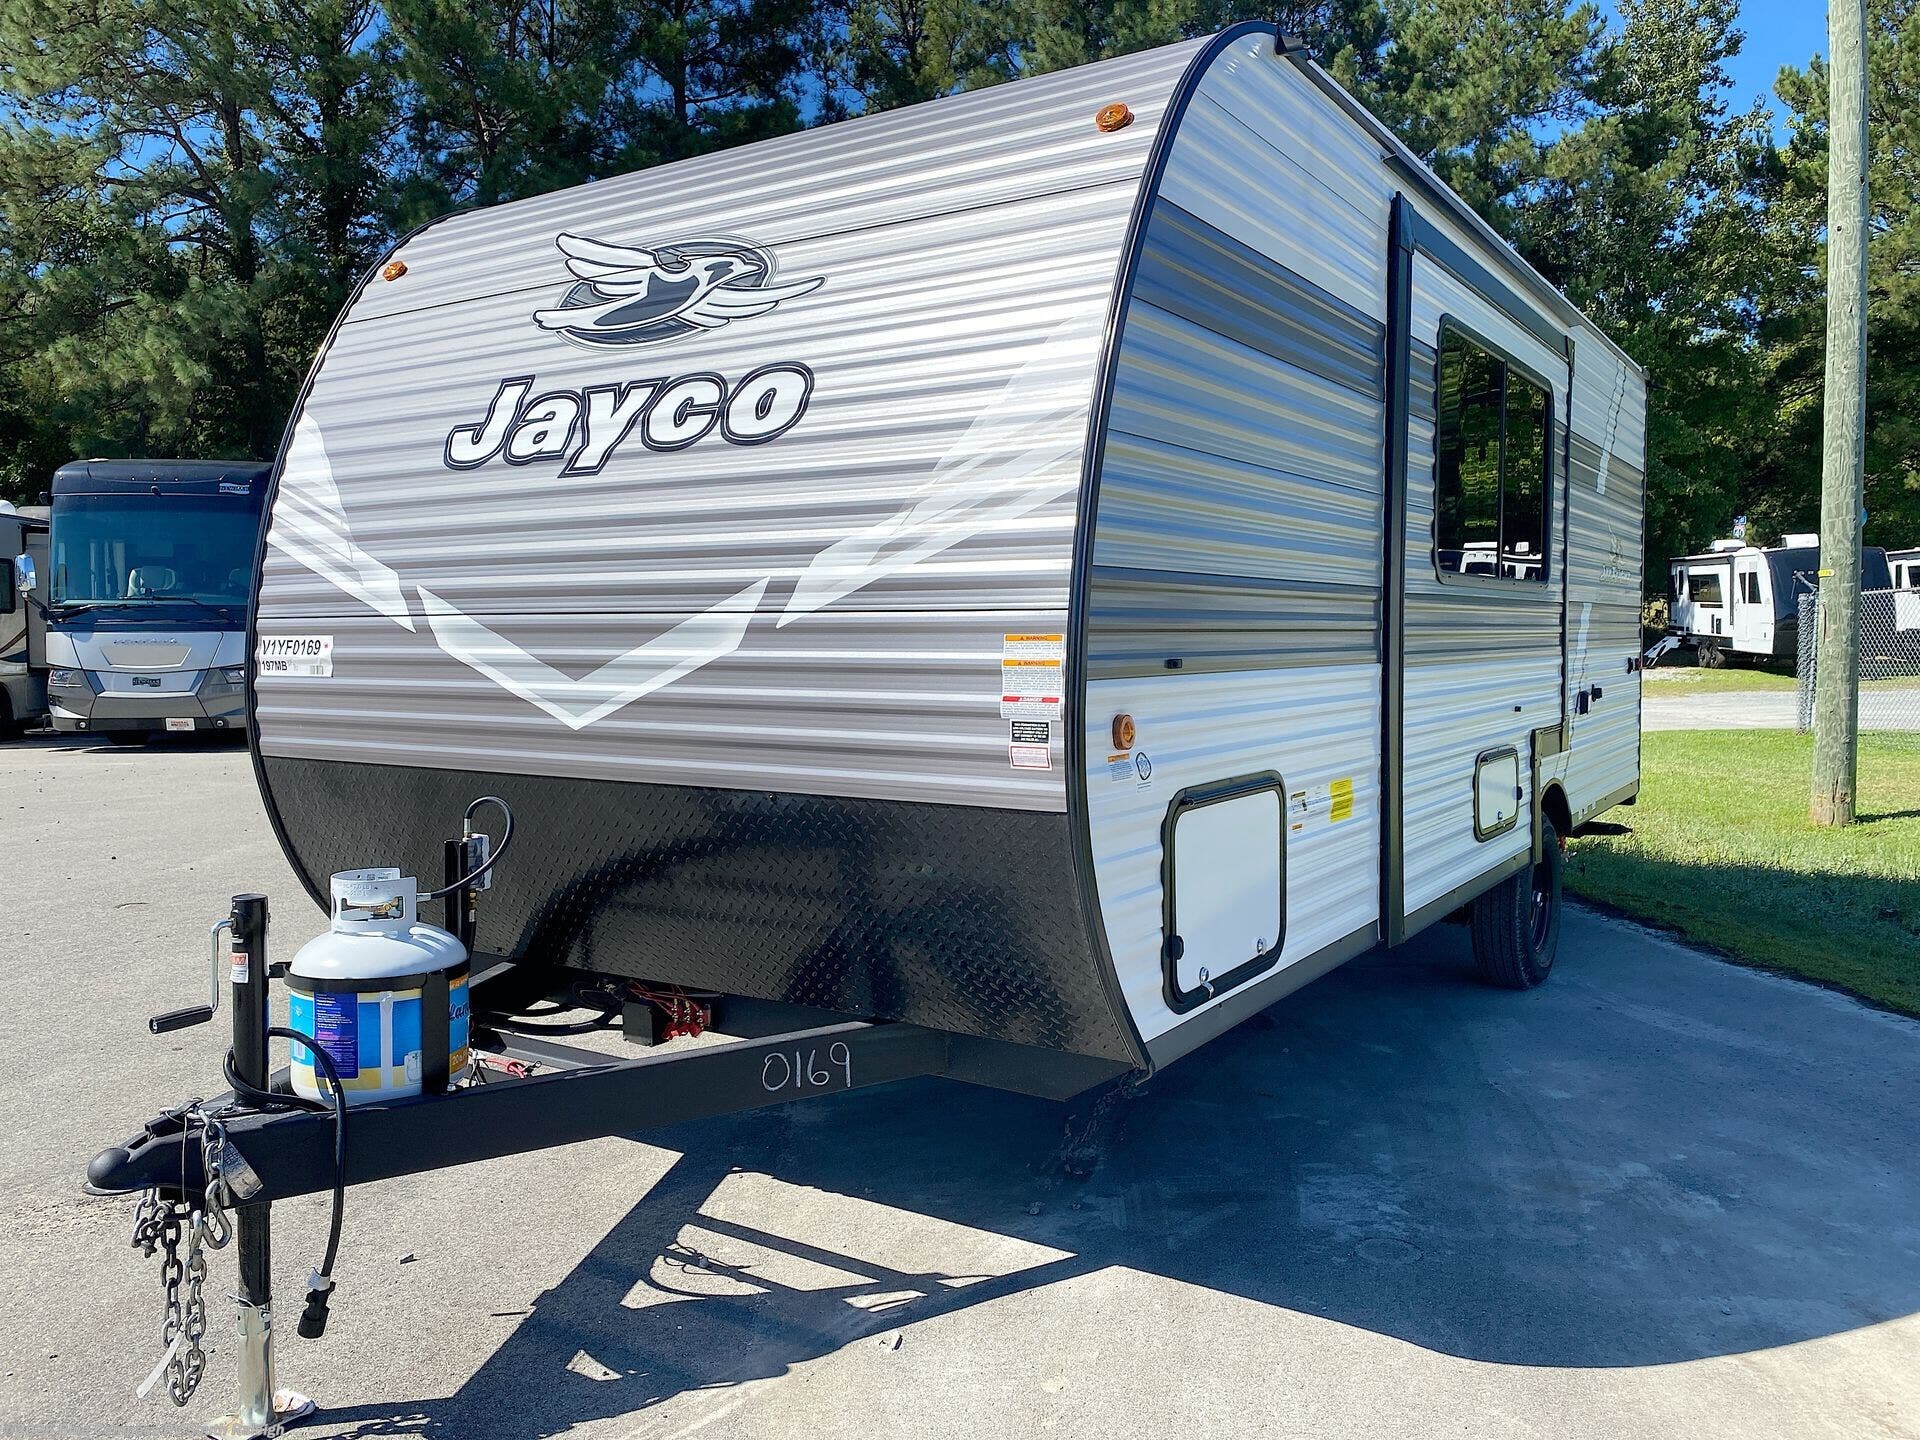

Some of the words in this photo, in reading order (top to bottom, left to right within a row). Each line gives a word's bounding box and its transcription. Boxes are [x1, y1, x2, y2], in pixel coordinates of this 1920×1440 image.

[443, 361, 815, 478] Jayco
[262, 639, 321, 656] V1YF0169
[261, 660, 288, 671] 197MB
[762, 1041, 851, 1092] 0169
